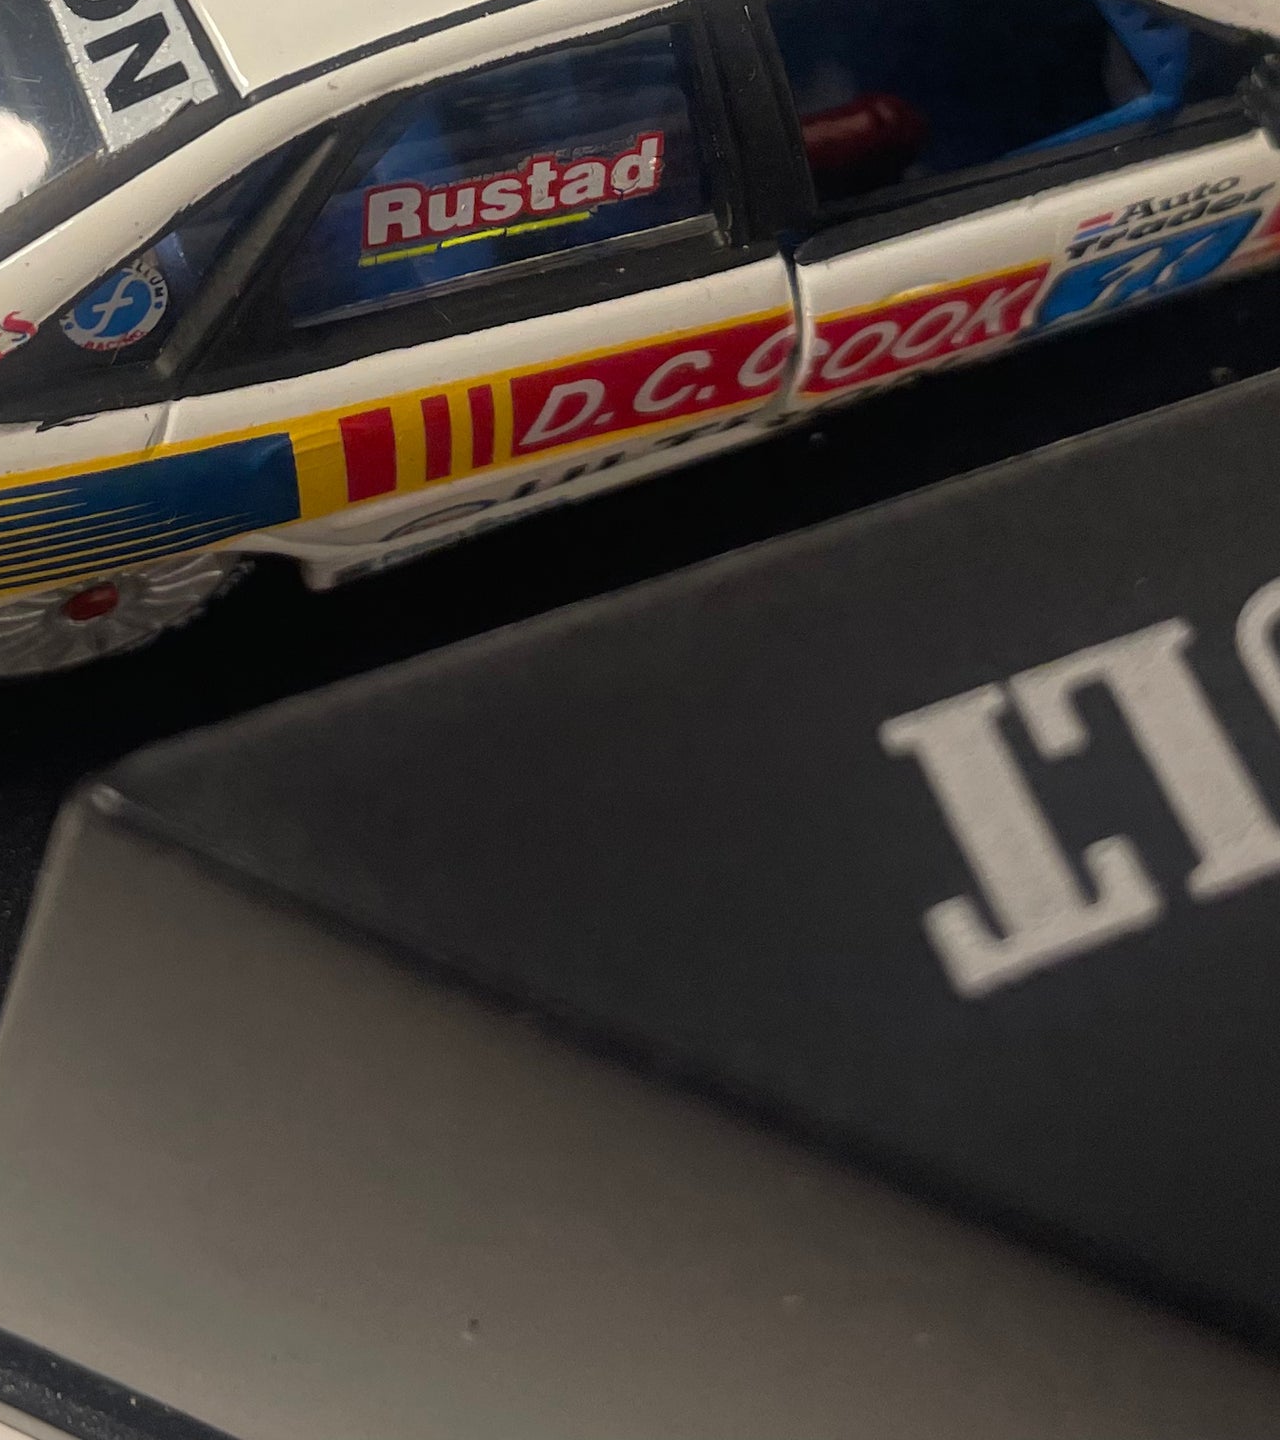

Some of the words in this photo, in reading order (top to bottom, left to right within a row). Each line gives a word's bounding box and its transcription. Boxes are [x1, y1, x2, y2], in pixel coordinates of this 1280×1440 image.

[368, 137, 659, 245] Rustad
[1067, 182, 1277, 260] Trader
[1120, 174, 1240, 221] Auto
